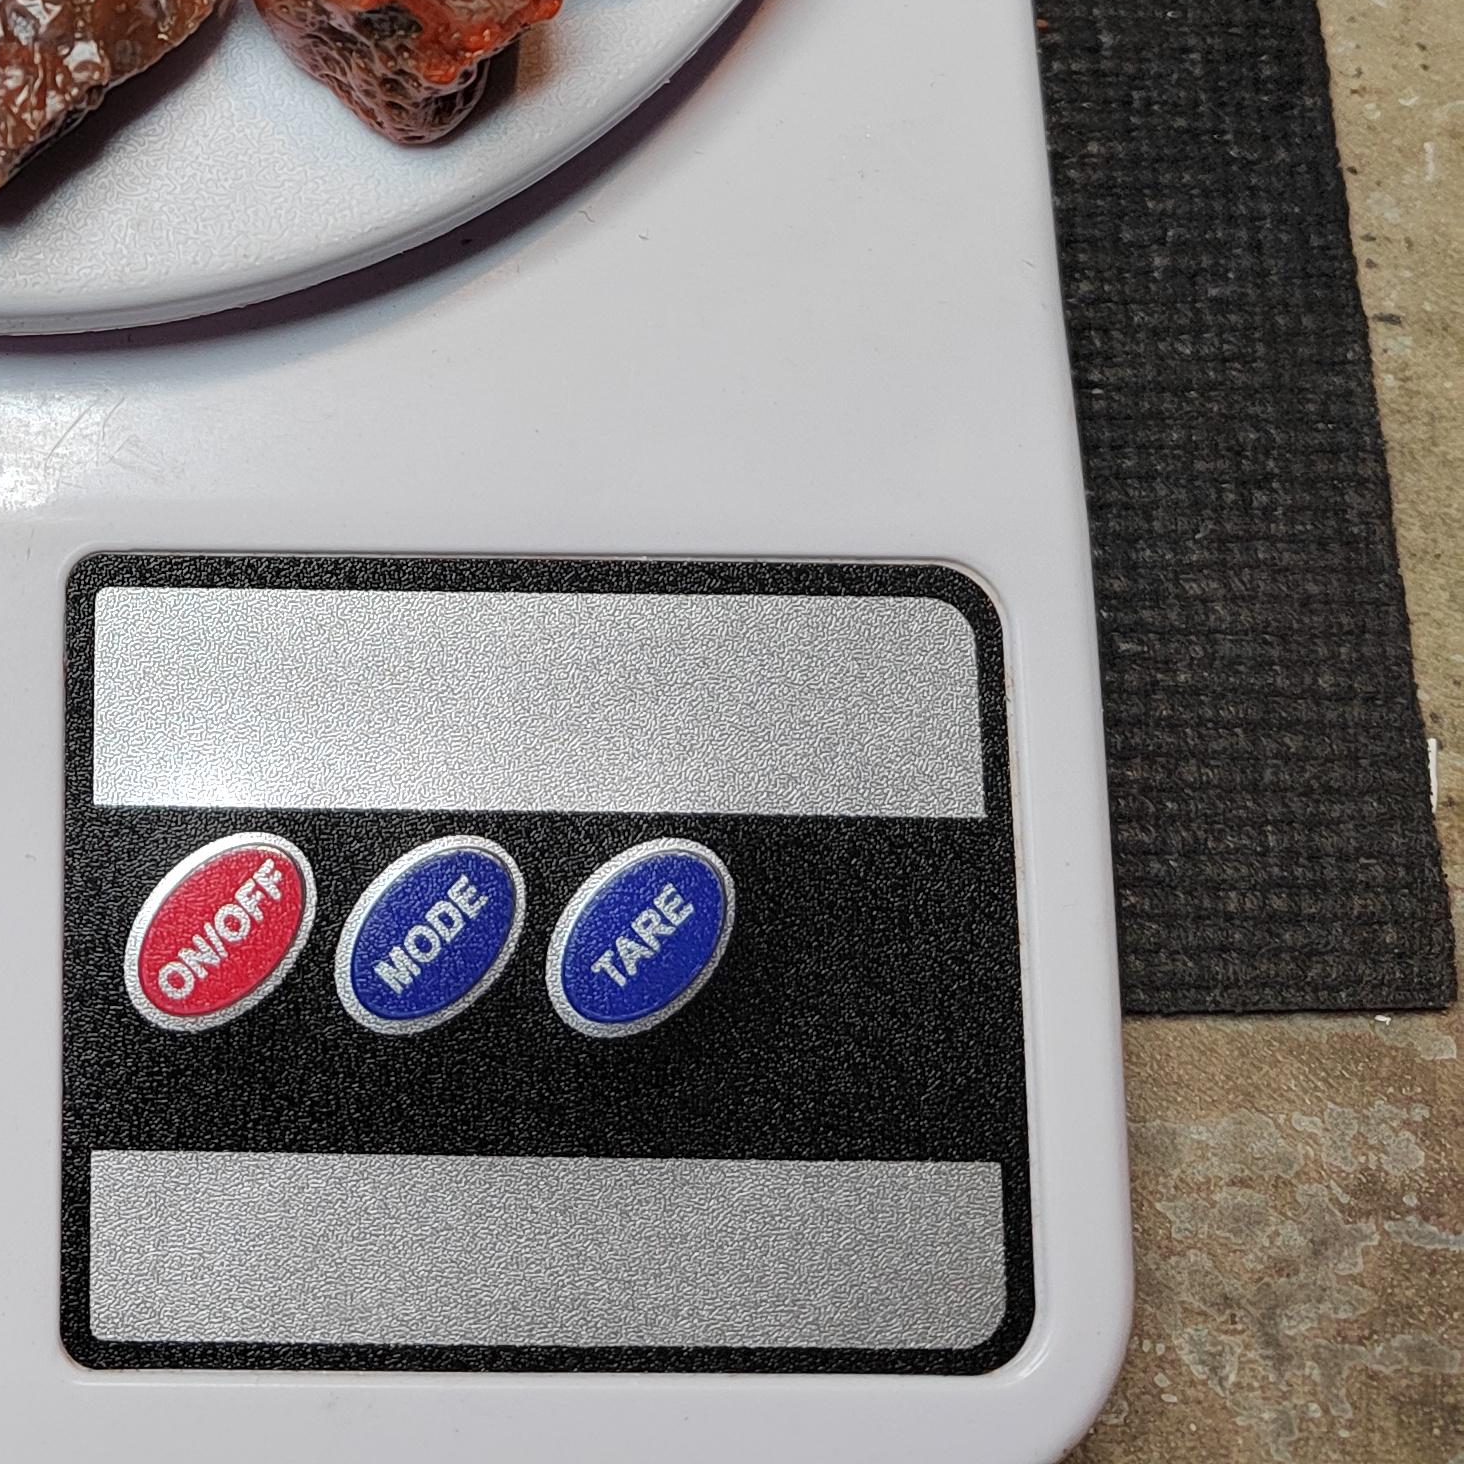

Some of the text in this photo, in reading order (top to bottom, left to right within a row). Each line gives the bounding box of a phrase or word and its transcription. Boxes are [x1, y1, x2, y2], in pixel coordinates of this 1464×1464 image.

[157, 856, 288, 1002] ON/OFF
[372, 873, 489, 998] MODE
[589, 882, 696, 990] TARE
